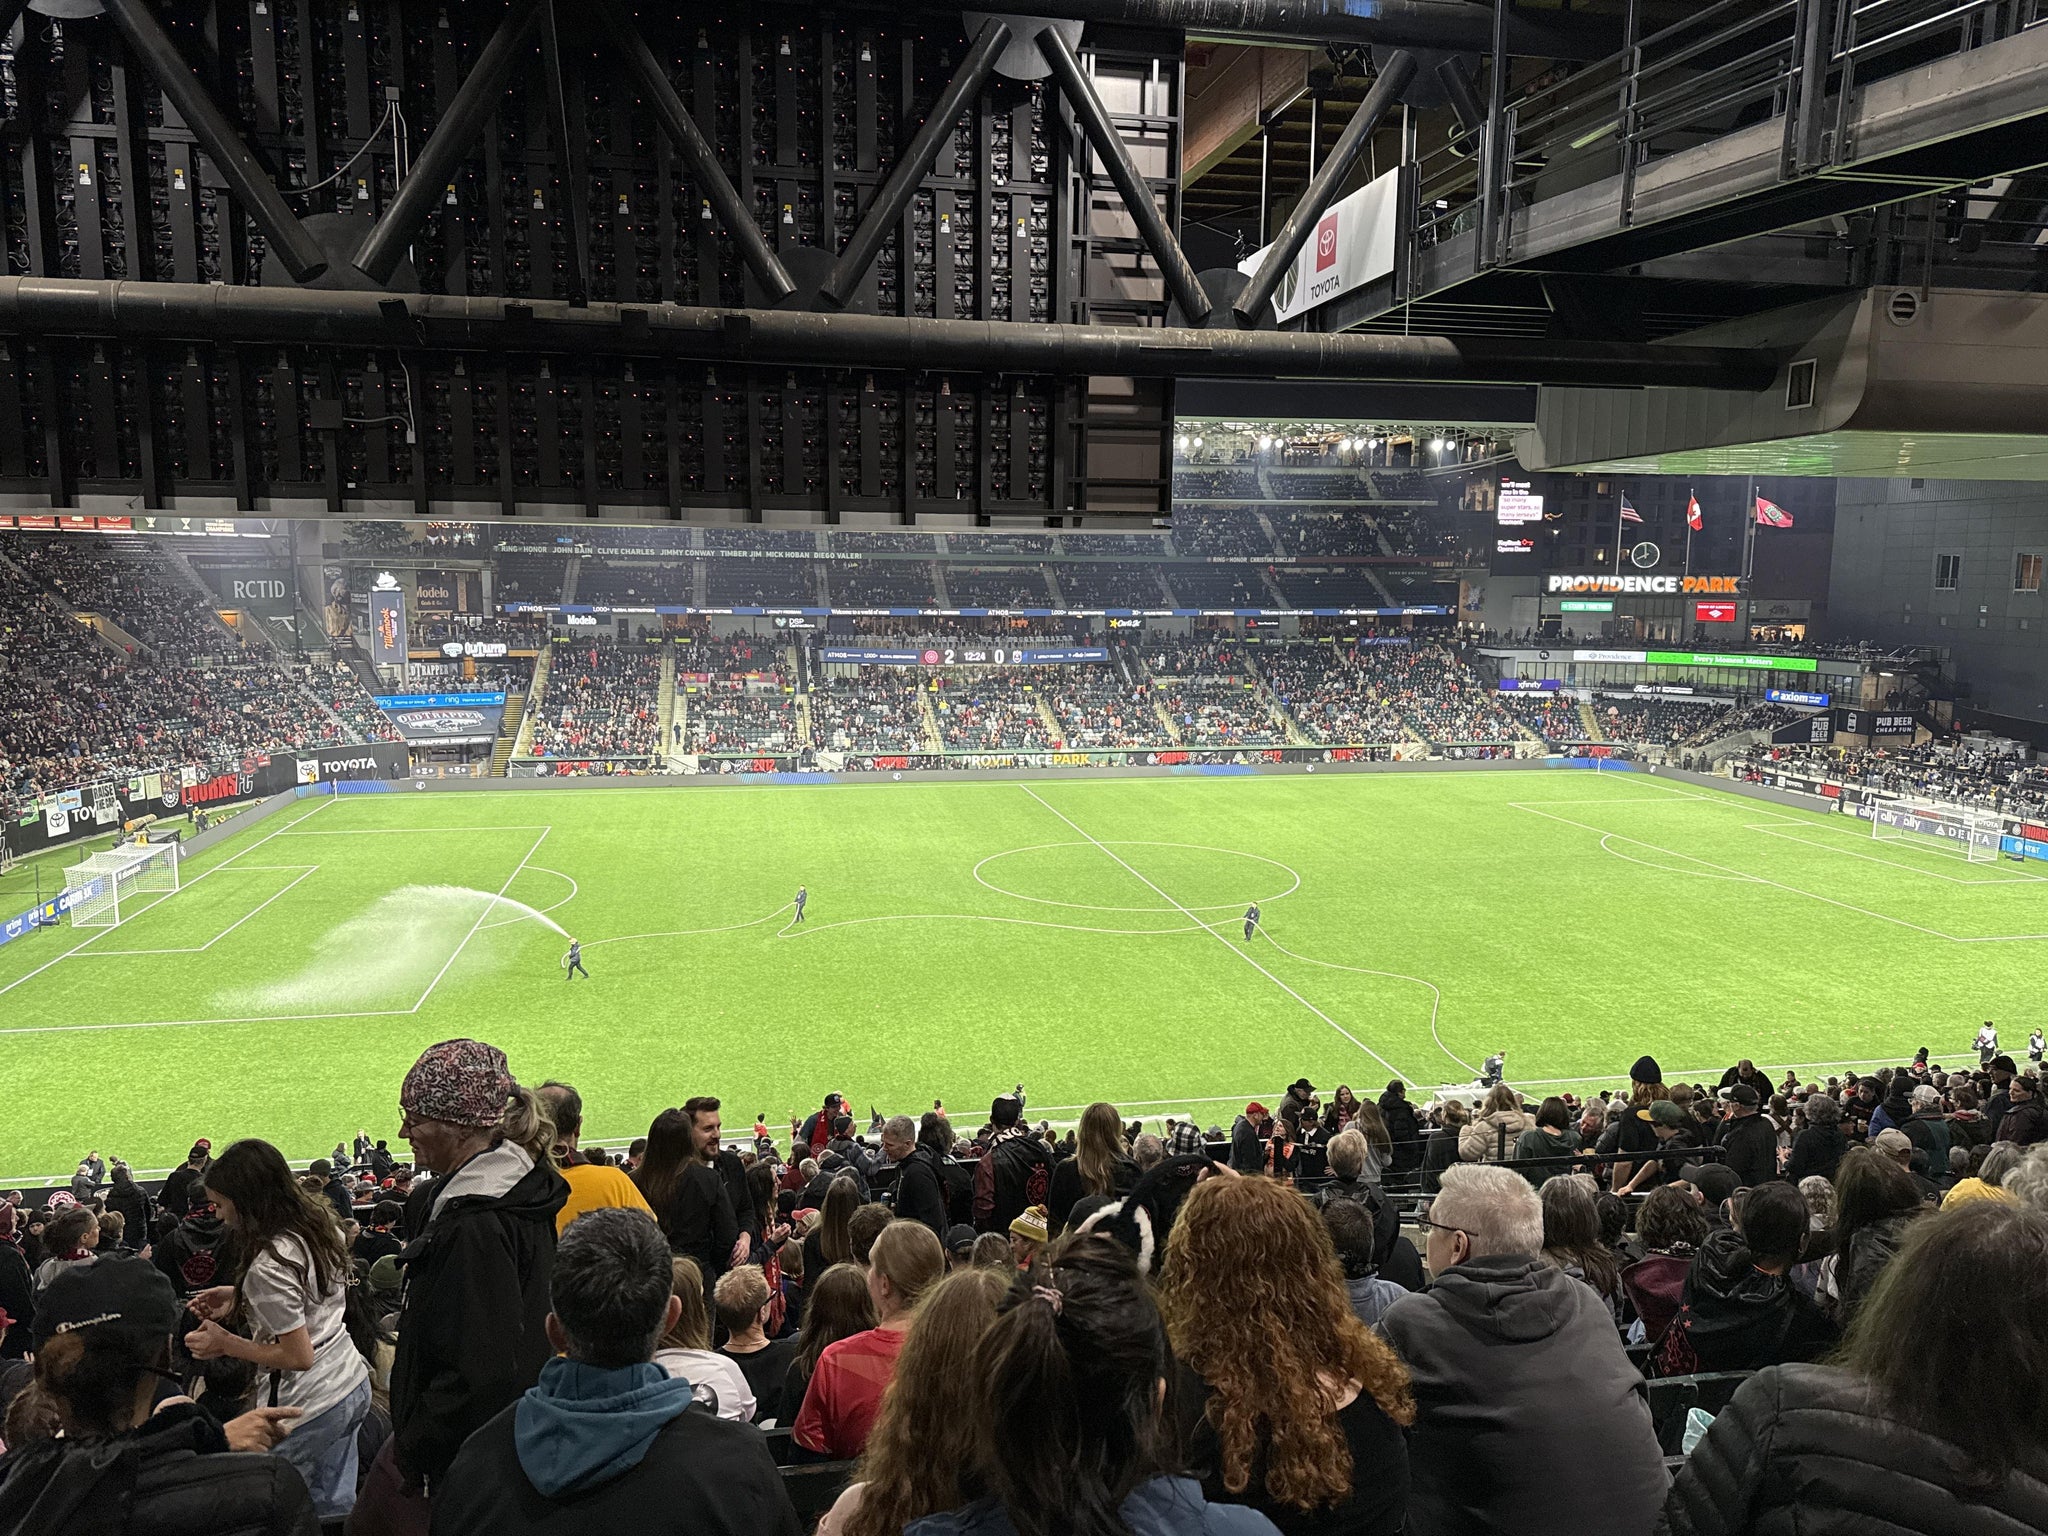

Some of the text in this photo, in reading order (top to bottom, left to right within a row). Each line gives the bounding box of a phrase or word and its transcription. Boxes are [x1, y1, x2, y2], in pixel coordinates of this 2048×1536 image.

[1311, 274, 1340, 299] TOYOTA
[574, 547, 593, 555] BAIN
[233, 580, 286, 599] RCTID
[1549, 575, 1740, 593] PROVIDENCE PARK
[567, 615, 597, 625] Modelo
[945, 650, 1005, 664] 2 12:24 0
[1599, 652, 1632, 660] Providence
[1693, 655, 1773, 666] Every Moment Matters
[1518, 681, 1542, 689] xfinity
[445, 697, 459, 705] ring
[1780, 692, 1809, 701] axiom
[1812, 721, 1829, 731] PUB
[1876, 716, 1913, 726] PUB BEER
[1811, 730, 1828, 738] BEER
[322, 757, 377, 774] TOYOTA
[1053, 753, 1090, 764] PARK
[1786, 779, 1804, 789] TOYOTA
[93, 784, 114, 799] RAISE
[72, 799, 124, 822] TOYA
[1859, 807, 1876, 821] ally
[1880, 808, 1898, 825] ally
[1903, 815, 1921, 831] ally
[1949, 827, 1991, 846] DELTA
[6, 917, 22, 934] prime
[55, 1312, 122, 1334] Champion
